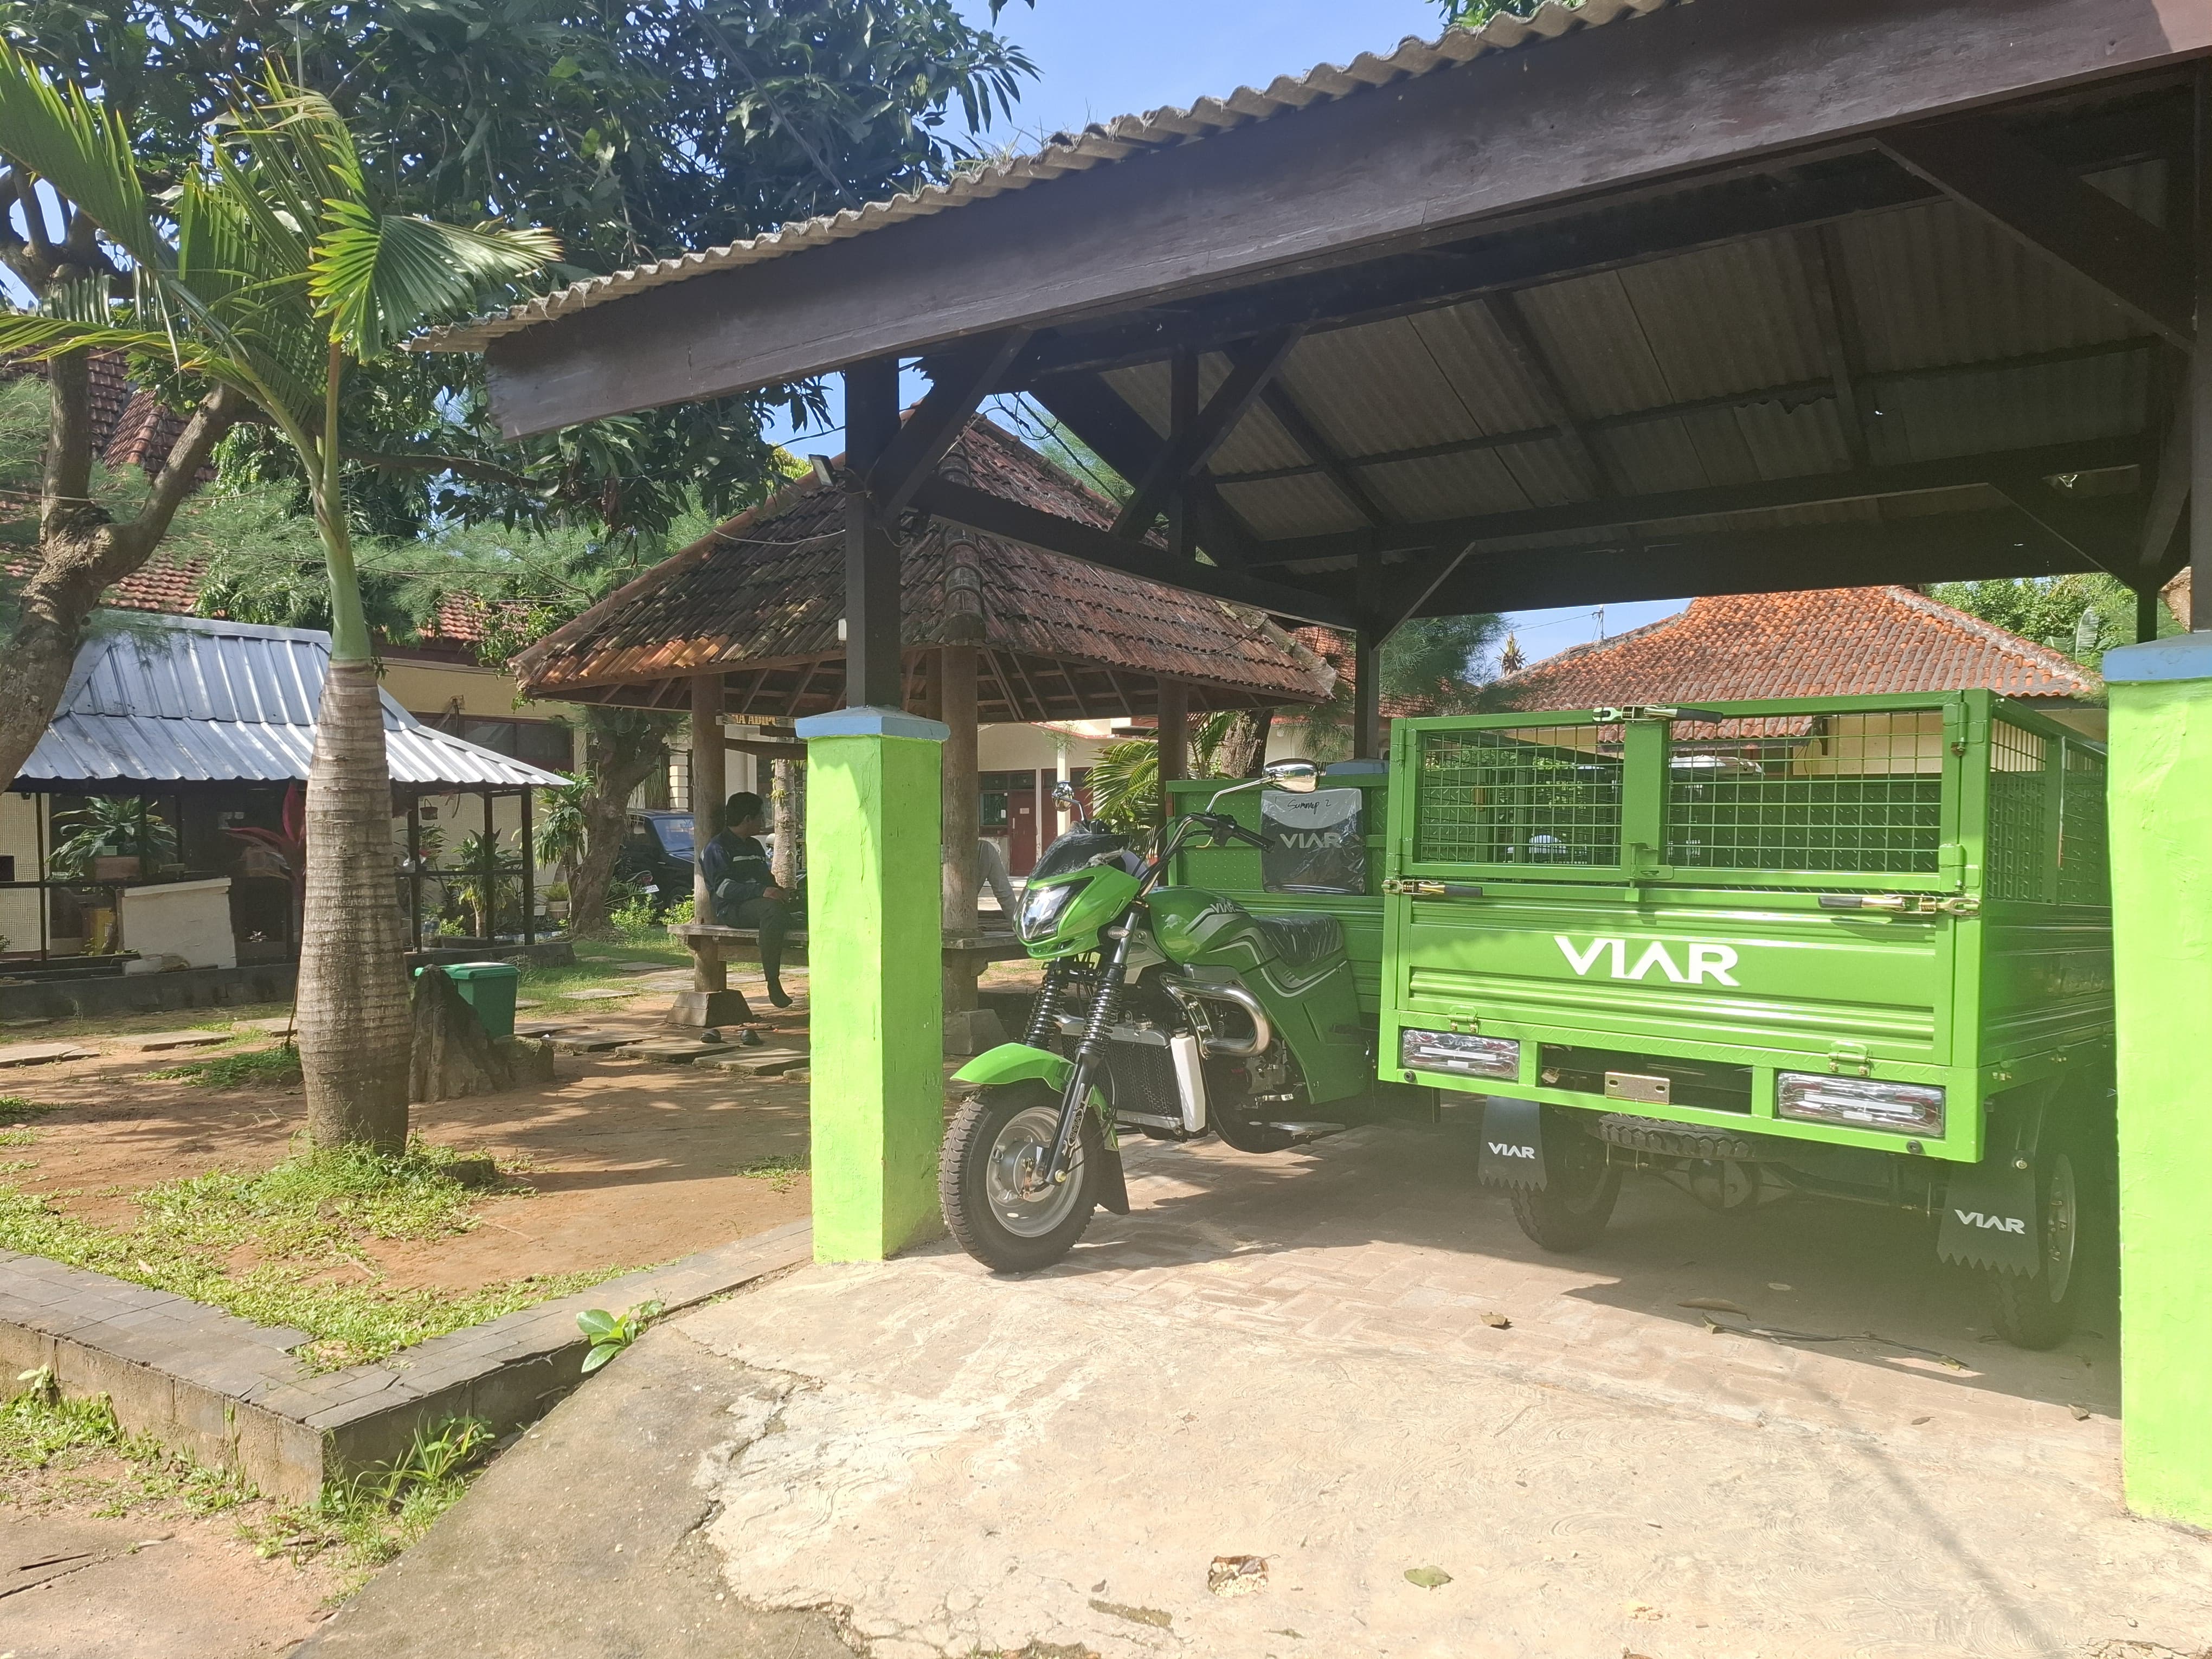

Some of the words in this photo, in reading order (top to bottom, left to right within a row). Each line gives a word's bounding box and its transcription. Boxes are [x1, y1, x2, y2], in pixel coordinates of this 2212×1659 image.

[1279, 833, 1342, 849] VIAR
[1210, 902, 1236, 913] VIAR
[1553, 935, 1741, 987] VIAR
[1069, 1115, 1083, 1140] VIAR
[1488, 1142, 1535, 1159] VIAR
[1954, 1209, 2025, 1234] VIAR
